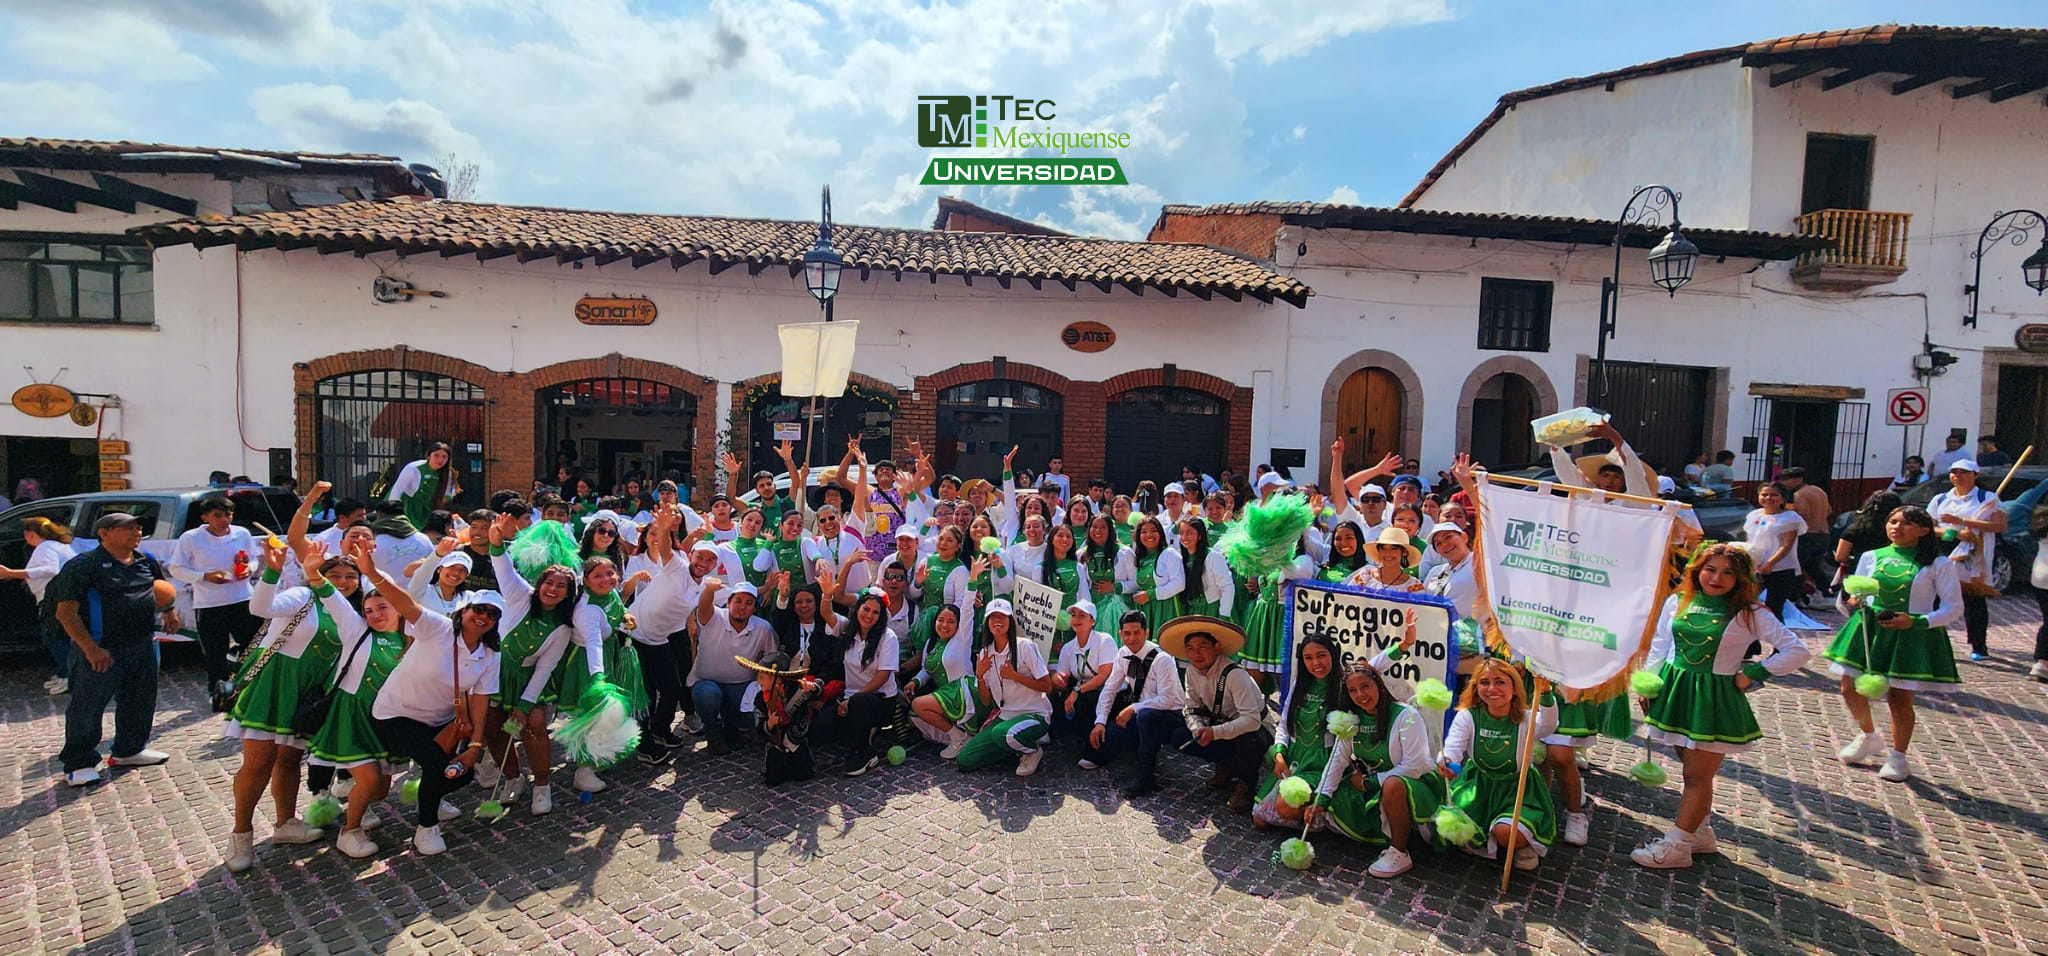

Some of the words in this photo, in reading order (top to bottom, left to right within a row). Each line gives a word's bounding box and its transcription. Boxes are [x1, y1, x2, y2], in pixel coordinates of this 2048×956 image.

[576, 303, 637, 320] Sonart
[1082, 331, 1112, 343] AT&T
[1900, 397, 1917, 416] E
[1542, 541, 1619, 567] Mexiquense
[1507, 554, 1606, 584] UNIVERSIDAD
[1023, 591, 1053, 609] pueblo
[1500, 595, 1576, 620] Licenciatura
[1579, 614, 1595, 624] en
[1041, 608, 1057, 622] tiene
[1297, 589, 1404, 633] Sufragio
[1026, 627, 1045, 641] digna
[1041, 623, 1054, 633] una
[1499, 611, 1606, 642] DMINISTRACIÓN
[1415, 639, 1446, 661] no
